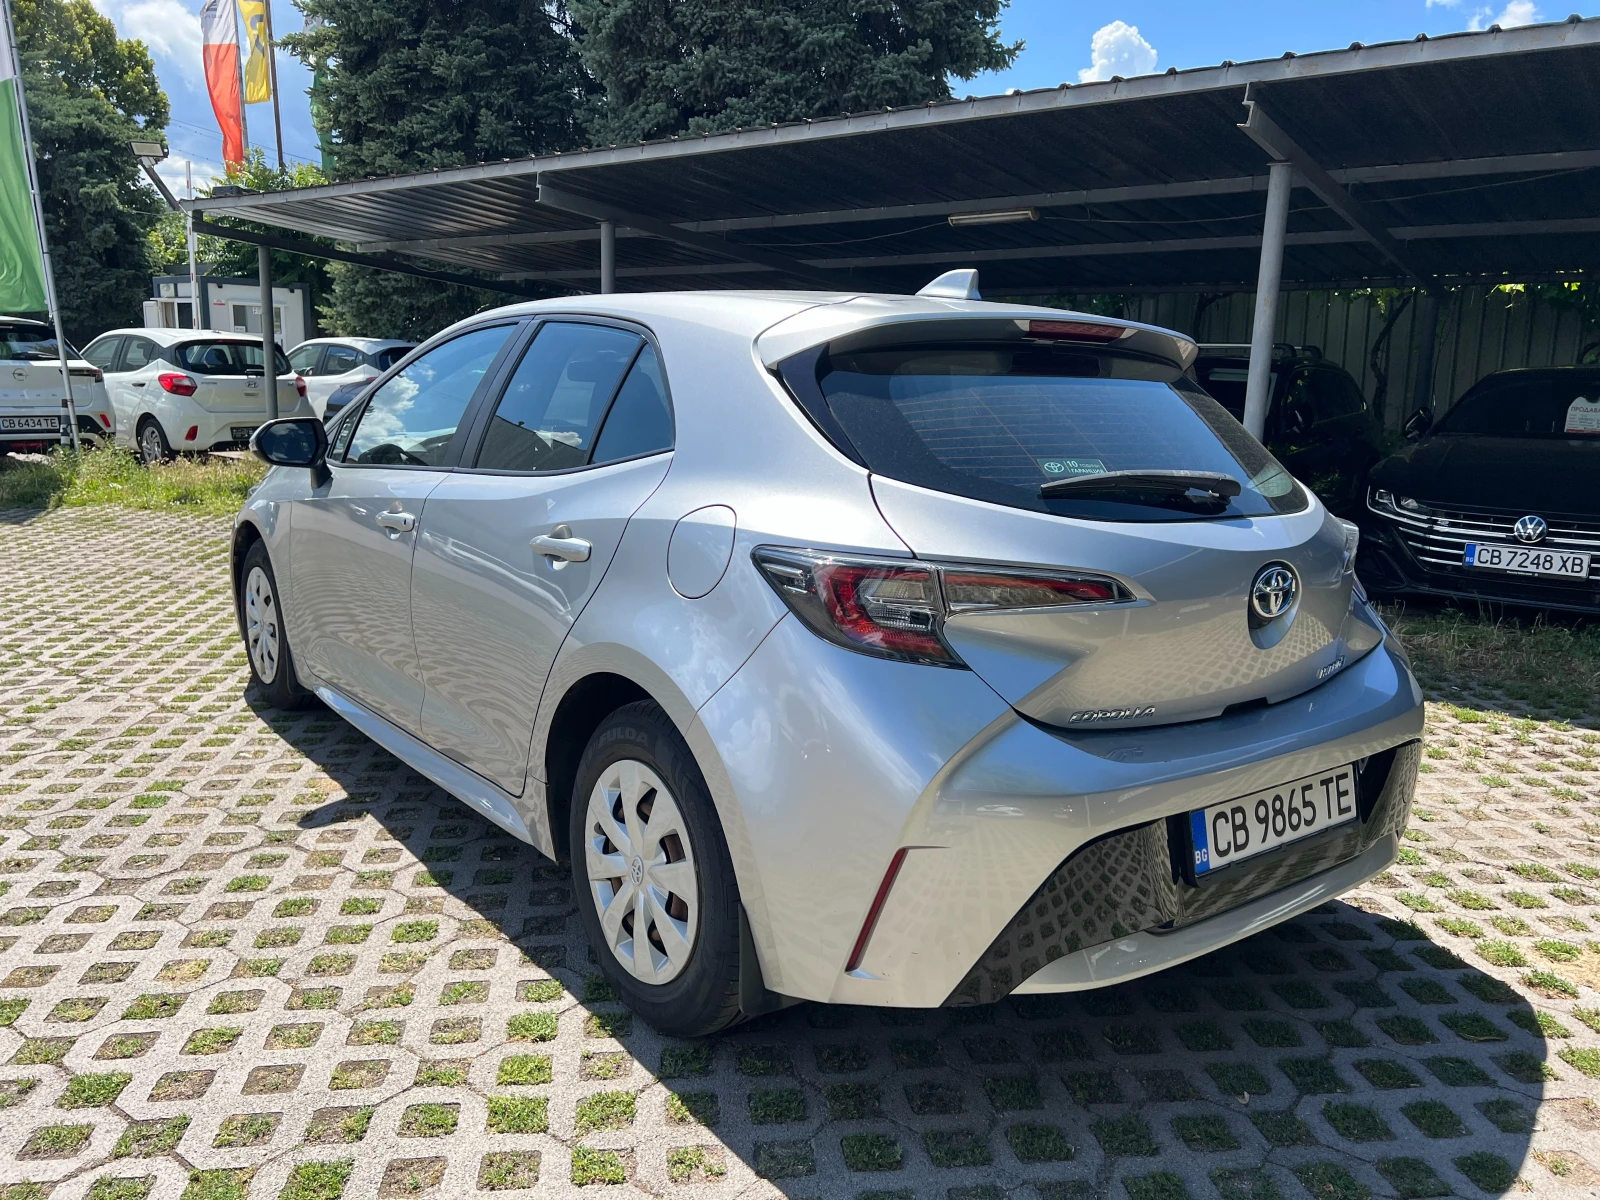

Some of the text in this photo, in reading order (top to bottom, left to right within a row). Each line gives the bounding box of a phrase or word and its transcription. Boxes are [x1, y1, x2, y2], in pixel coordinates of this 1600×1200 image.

[2, 418, 58, 429] CB 6434 TE
[1066, 460, 1079, 468] 10
[1477, 548, 1584, 574] CB 7248 XB
[1068, 705, 1156, 724] COROLLA
[598, 726, 649, 750] FULDA
[1212, 772, 1352, 858] CB 9865 TE
[1194, 848, 1209, 864] BG
